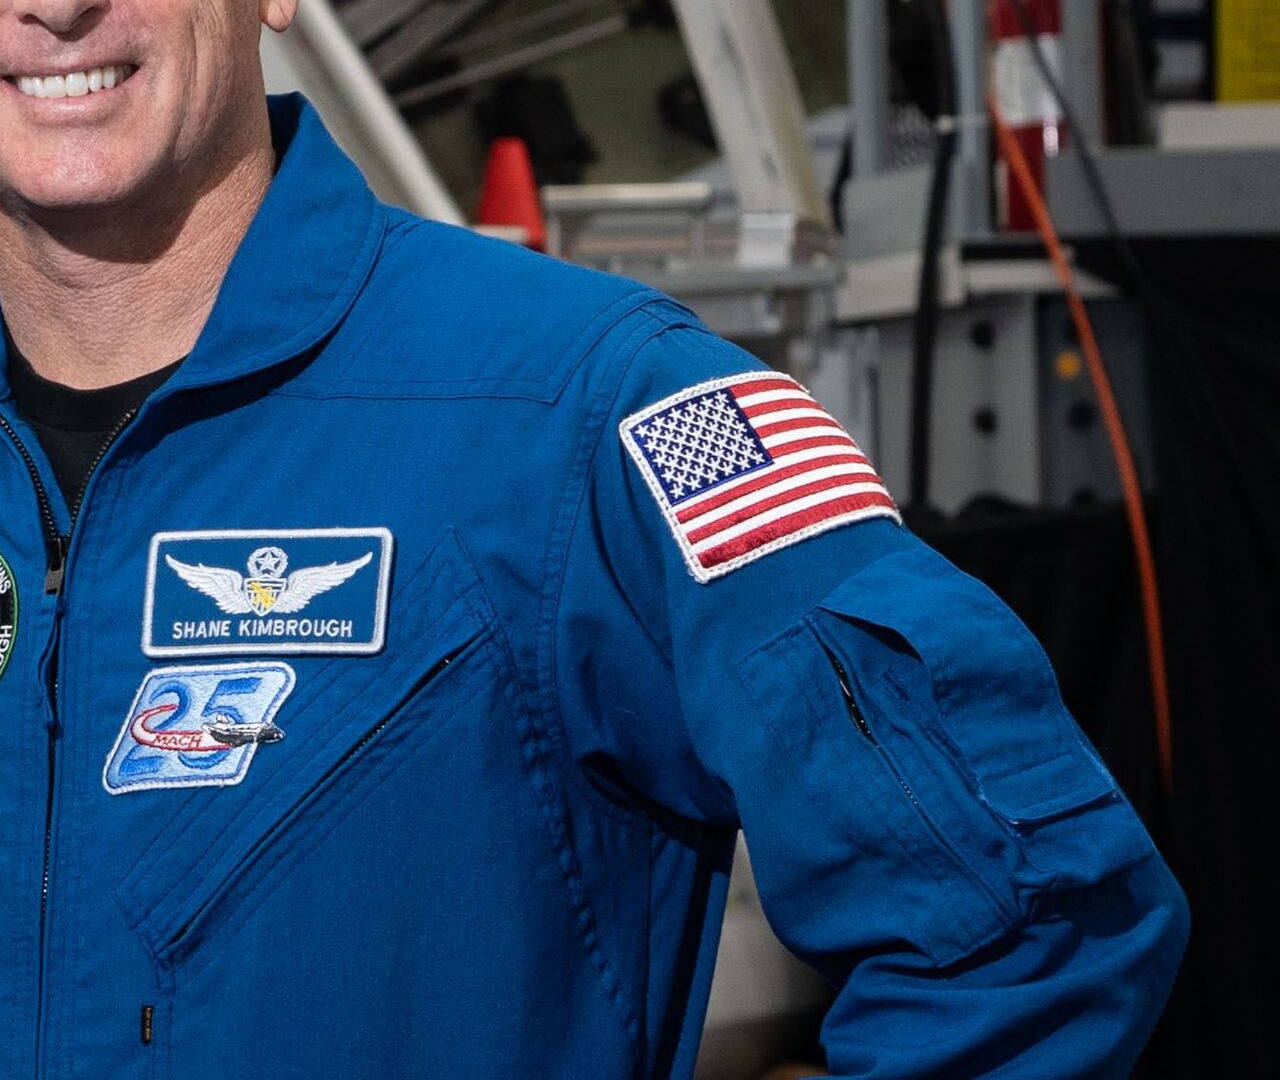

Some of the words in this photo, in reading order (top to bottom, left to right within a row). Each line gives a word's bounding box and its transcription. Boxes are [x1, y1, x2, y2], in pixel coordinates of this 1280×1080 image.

[172, 620, 231, 639] SHANE
[240, 620, 353, 638] KIMBROUGH
[118, 677, 263, 775] 25
[152, 735, 204, 747] MACH
